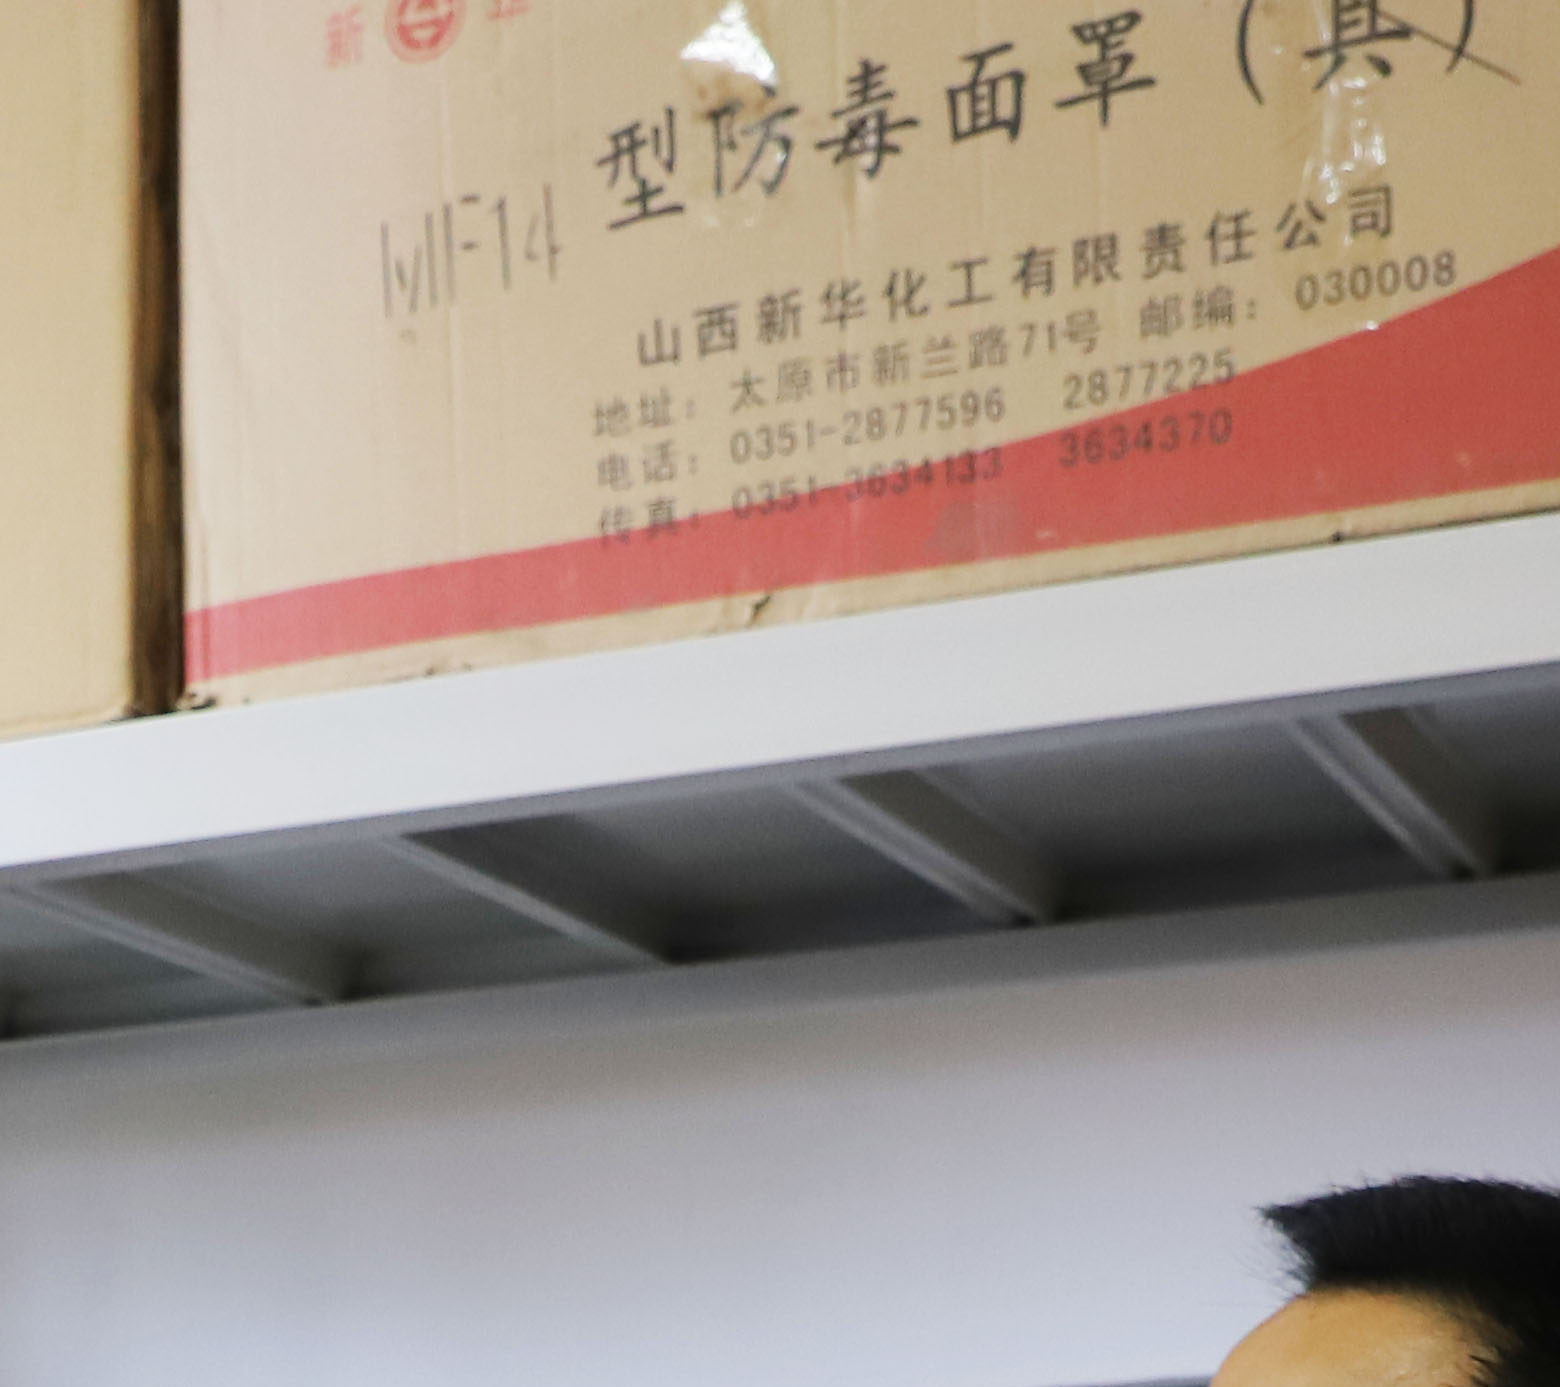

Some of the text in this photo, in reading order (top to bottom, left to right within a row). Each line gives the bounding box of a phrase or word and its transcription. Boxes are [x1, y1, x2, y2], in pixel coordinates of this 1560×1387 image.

[636, 183, 1396, 367] 山西新华化工有限责任公司
[1294, 250, 1458, 312] 030008
[730, 386, 1007, 464] 0351-2877596
[1062, 347, 1237, 411] 2877225
[1059, 407, 1234, 468] 3634370
